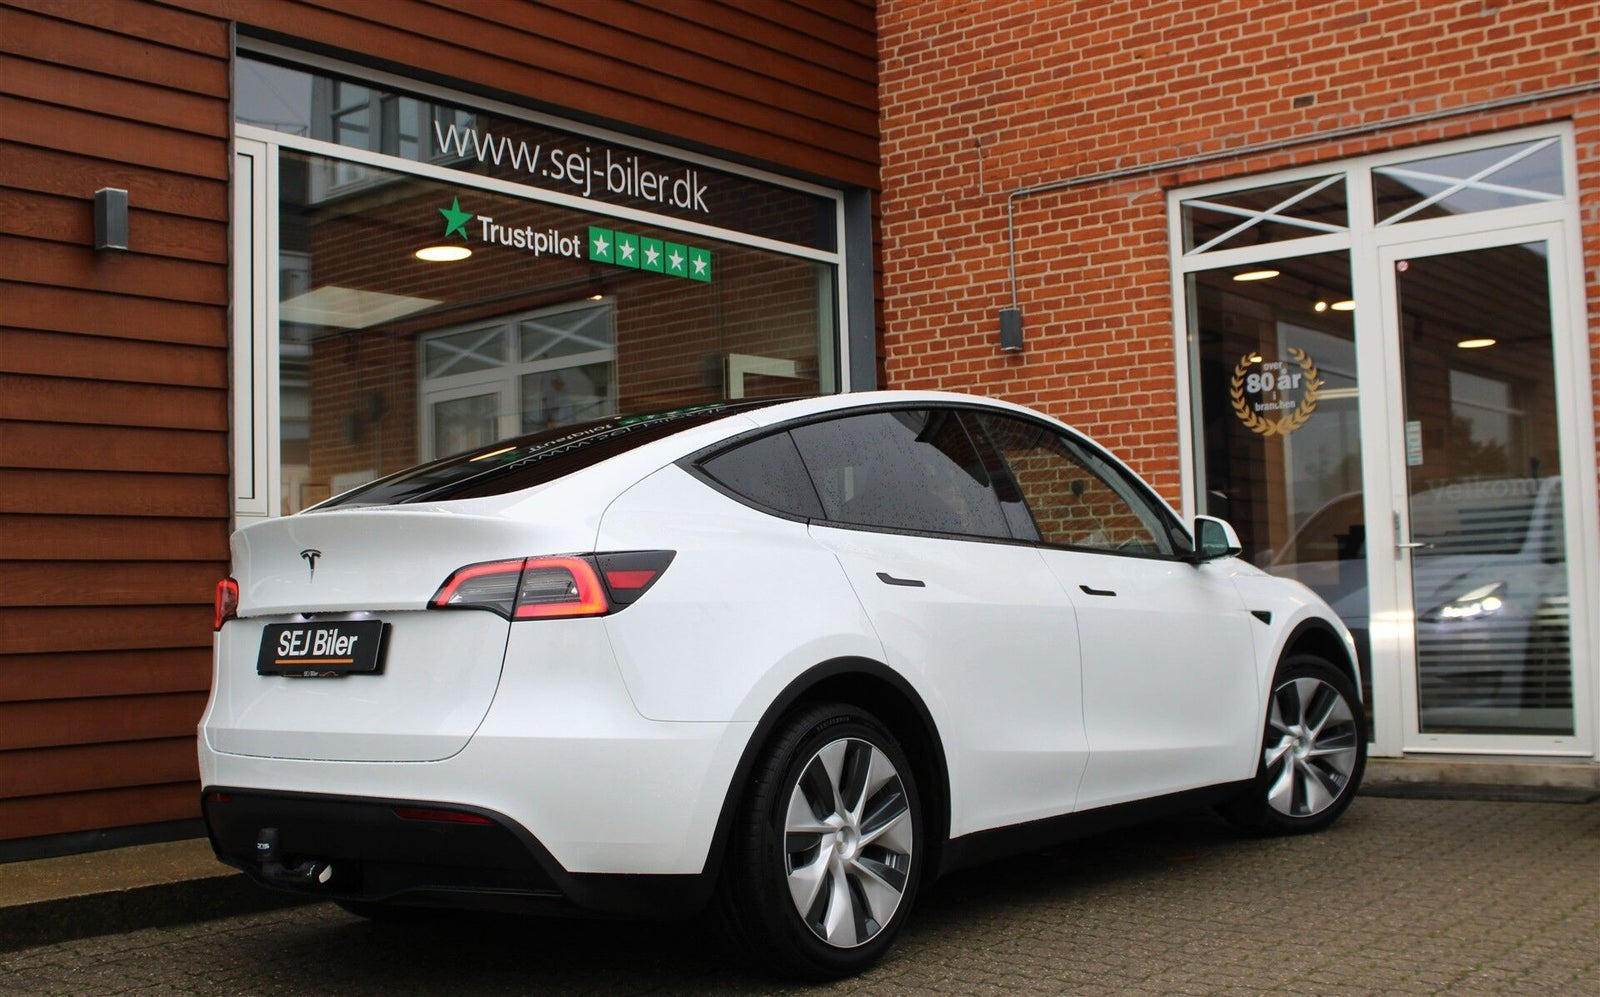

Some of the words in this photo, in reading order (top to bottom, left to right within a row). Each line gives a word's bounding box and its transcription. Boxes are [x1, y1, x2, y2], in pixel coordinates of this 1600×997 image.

[434, 120, 709, 213] www.sej-biler.dk
[477, 215, 581, 258] Trustpilot
[1263, 361, 1283, 370] over
[1246, 372, 1275, 393] 80
[1277, 368, 1302, 390] år
[277, 630, 312, 656] SEJ
[312, 628, 358, 656] Biler
